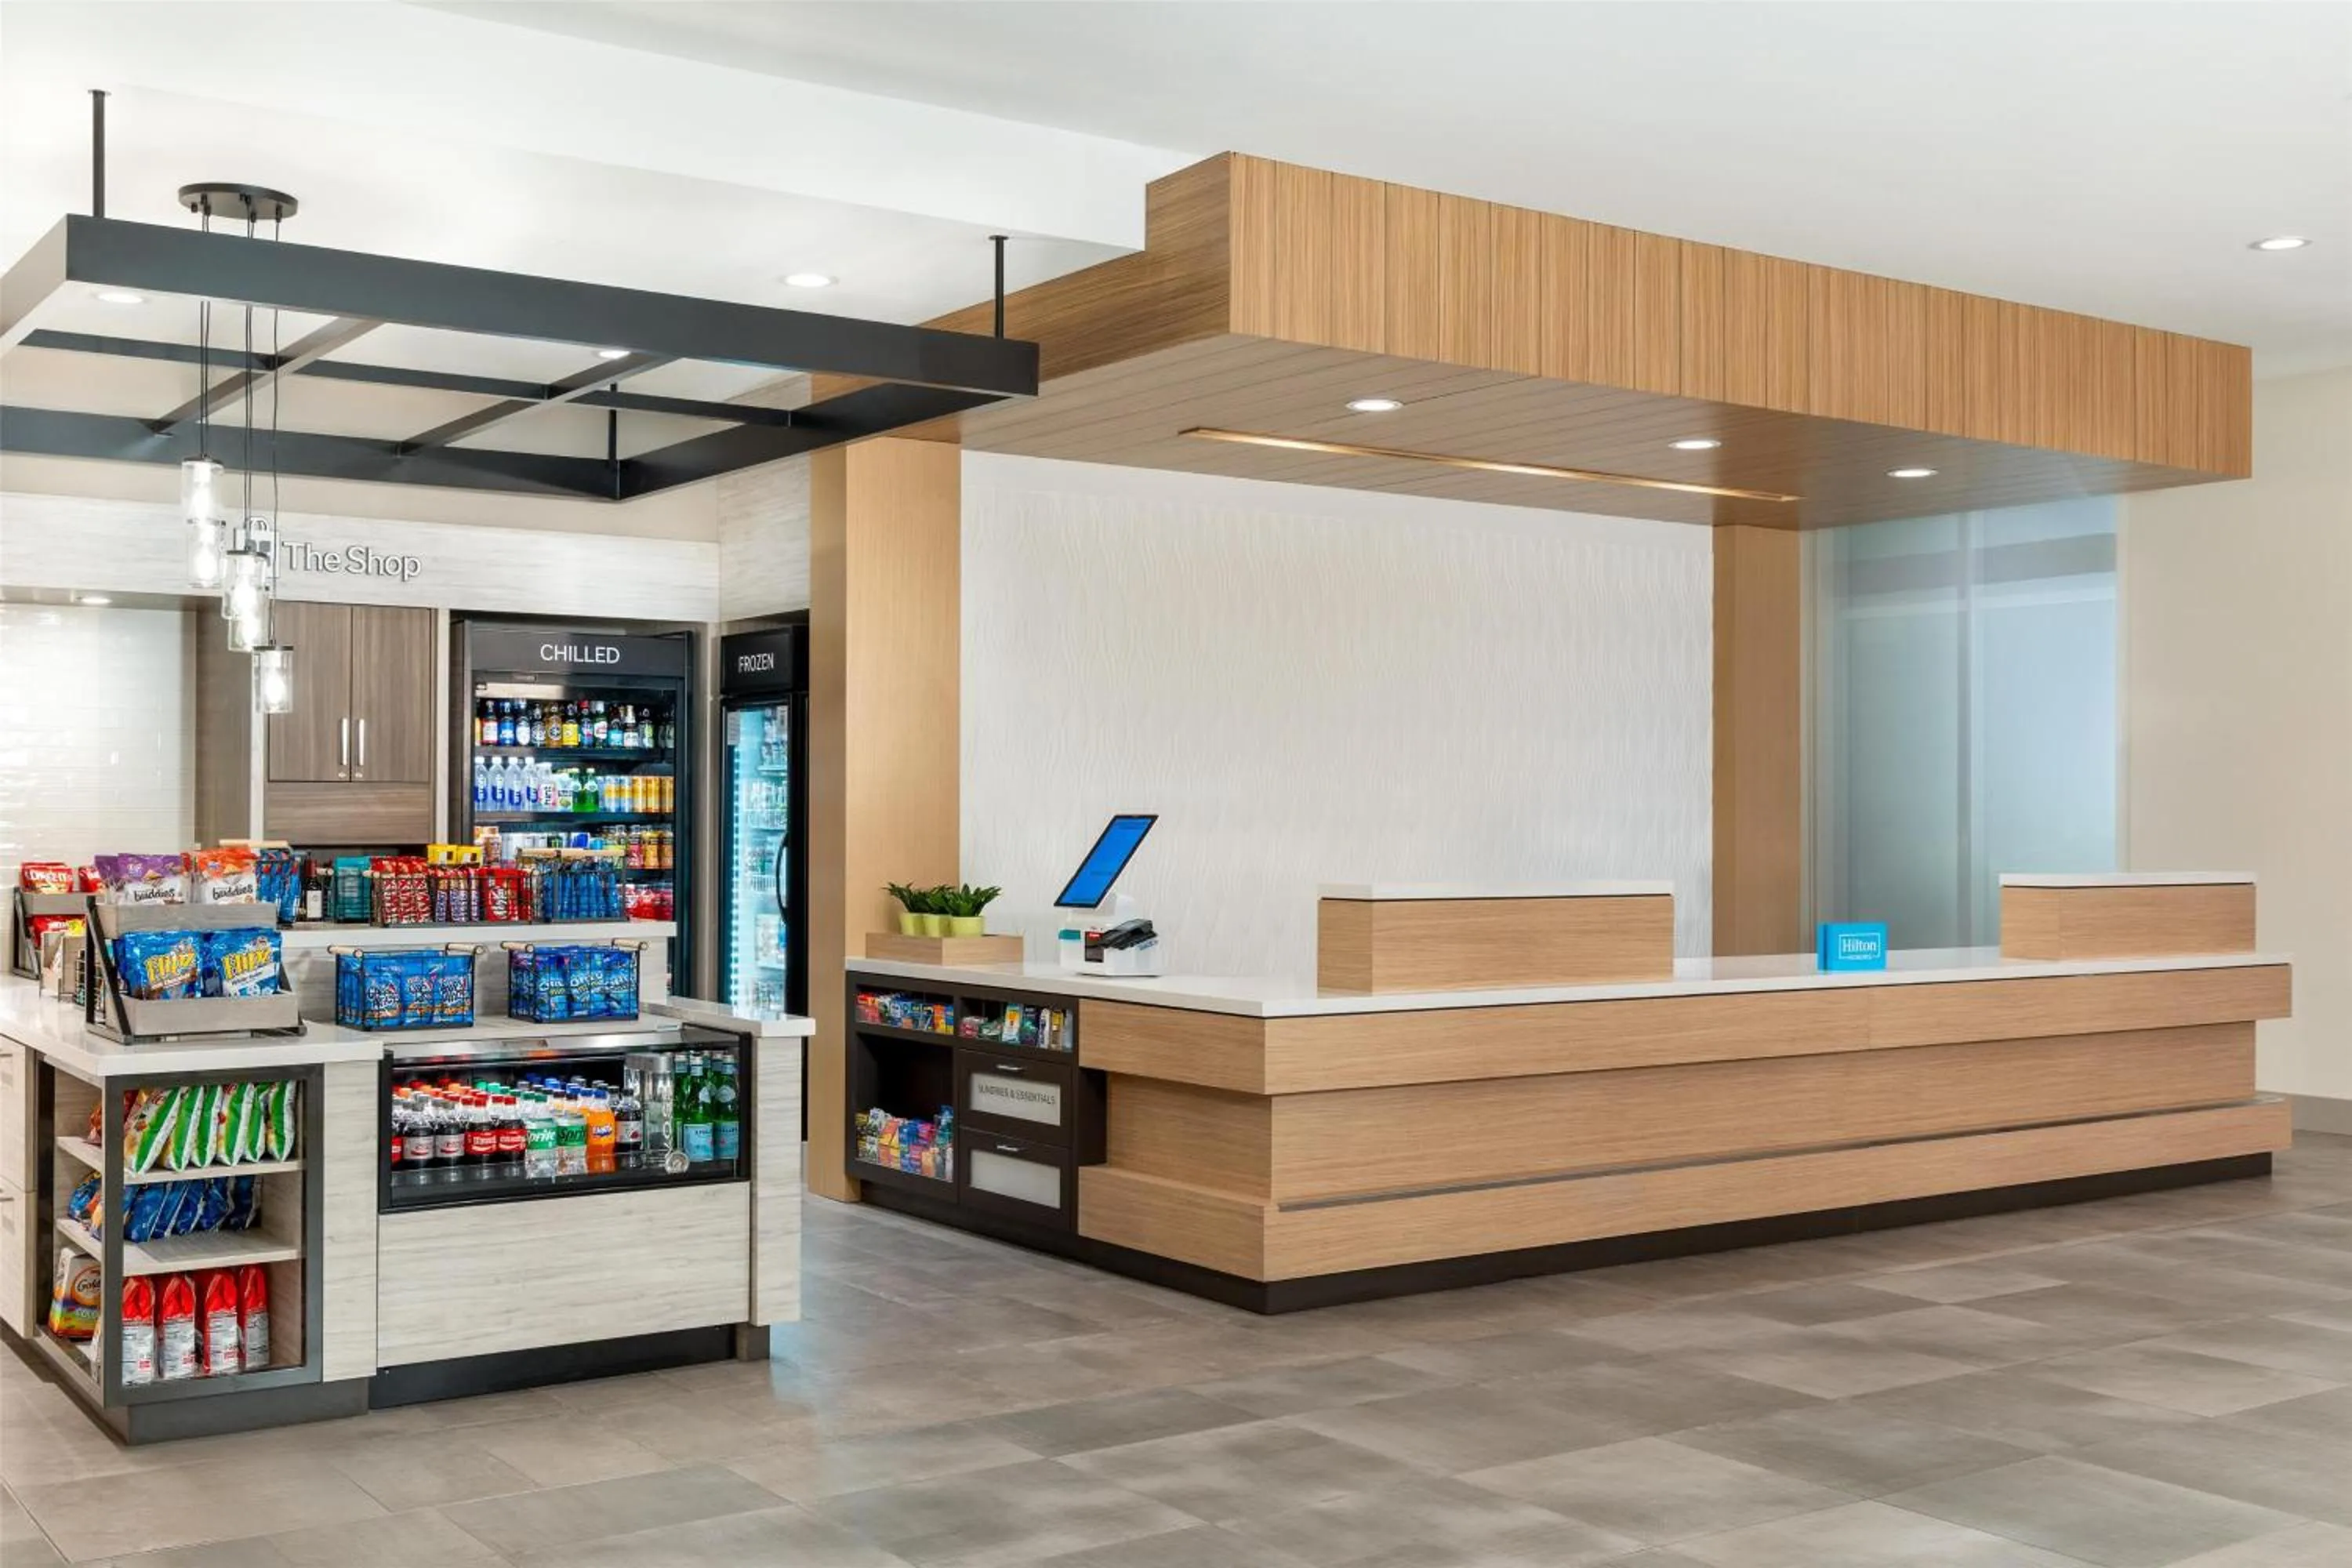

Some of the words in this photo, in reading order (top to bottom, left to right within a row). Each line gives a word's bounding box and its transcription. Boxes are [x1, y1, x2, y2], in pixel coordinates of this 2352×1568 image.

[281, 540, 342, 573] The
[344, 545, 422, 583] Shop
[539, 644, 621, 664] CHILLED
[738, 652, 775, 673] FROZEN
[133, 887, 176, 902] buddies
[212, 884, 253, 900] buddies
[1842, 938, 1877, 953] Hilton
[1015, 1090, 1056, 1105] ESSENTIALS
